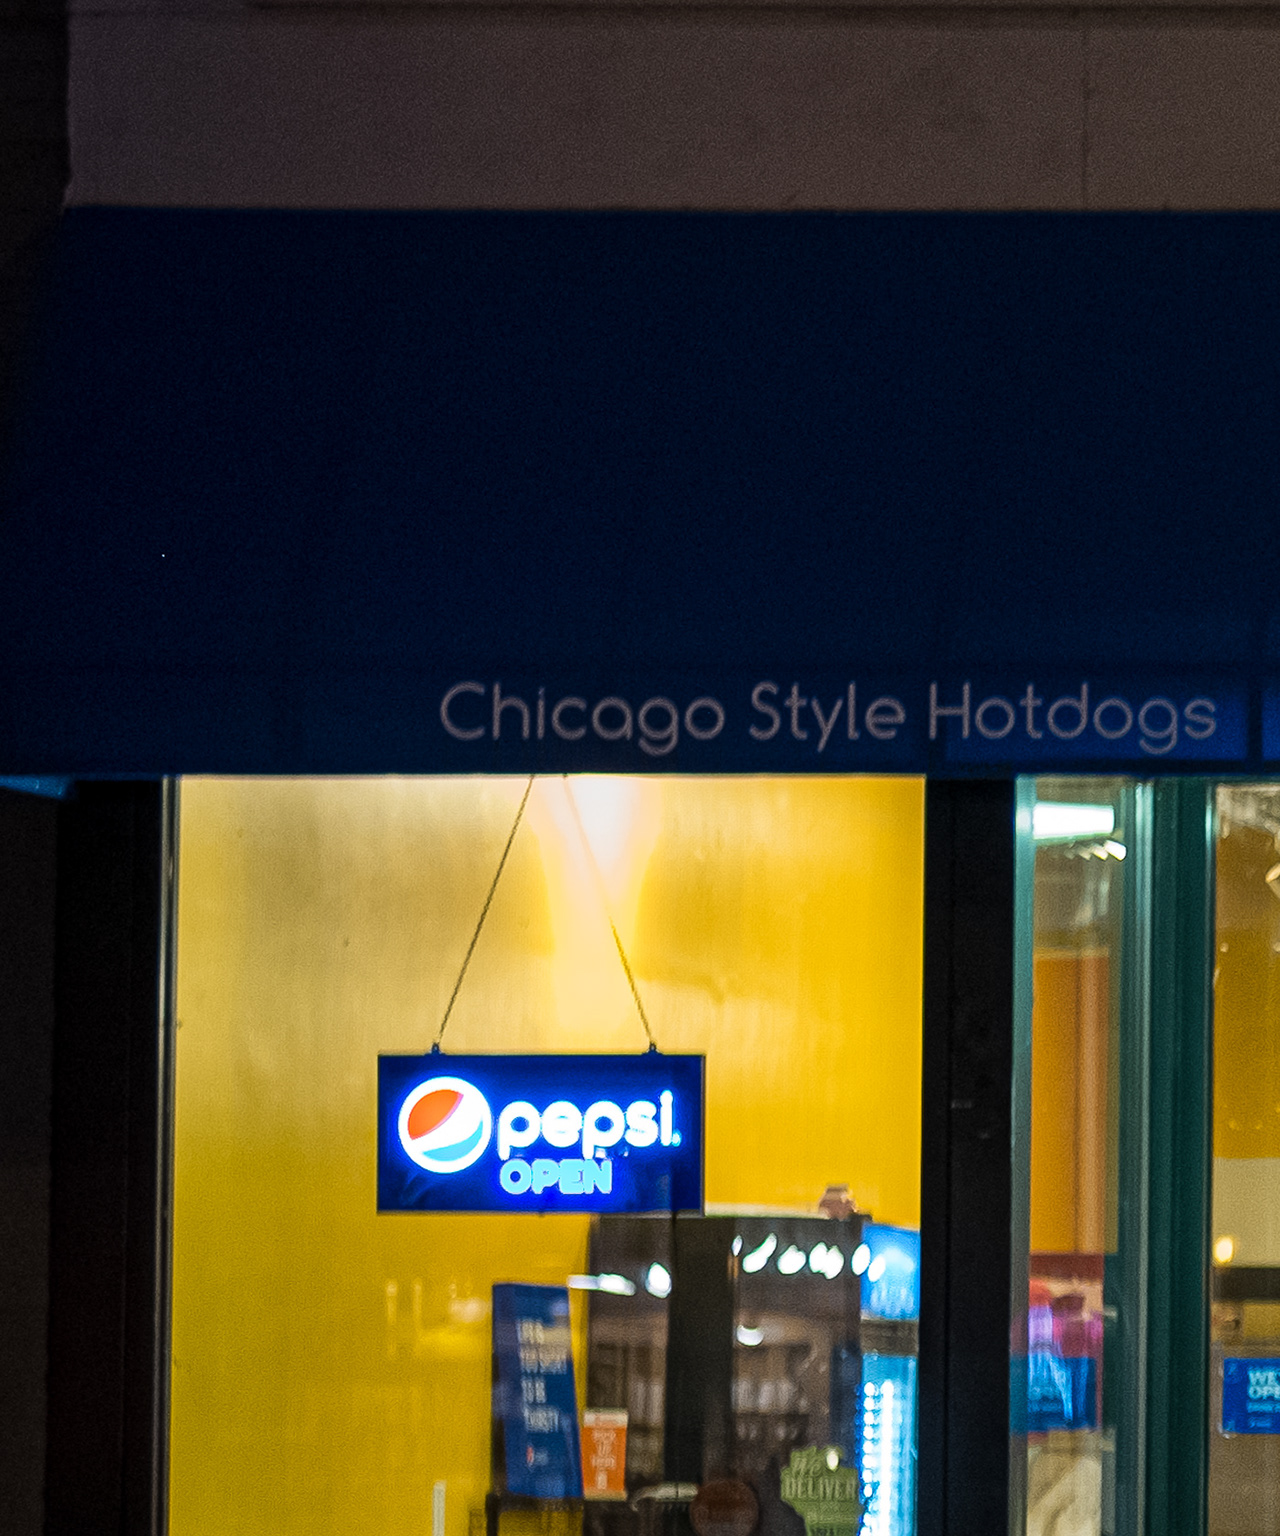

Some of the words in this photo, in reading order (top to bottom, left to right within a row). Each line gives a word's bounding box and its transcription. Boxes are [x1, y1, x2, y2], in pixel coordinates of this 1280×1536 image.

[439, 680, 726, 757] Chicago
[749, 680, 906, 754] Style
[928, 681, 1218, 755] Hotdogs
[498, 1089, 674, 1161] pepsi
[499, 1158, 613, 1195] OPEN
